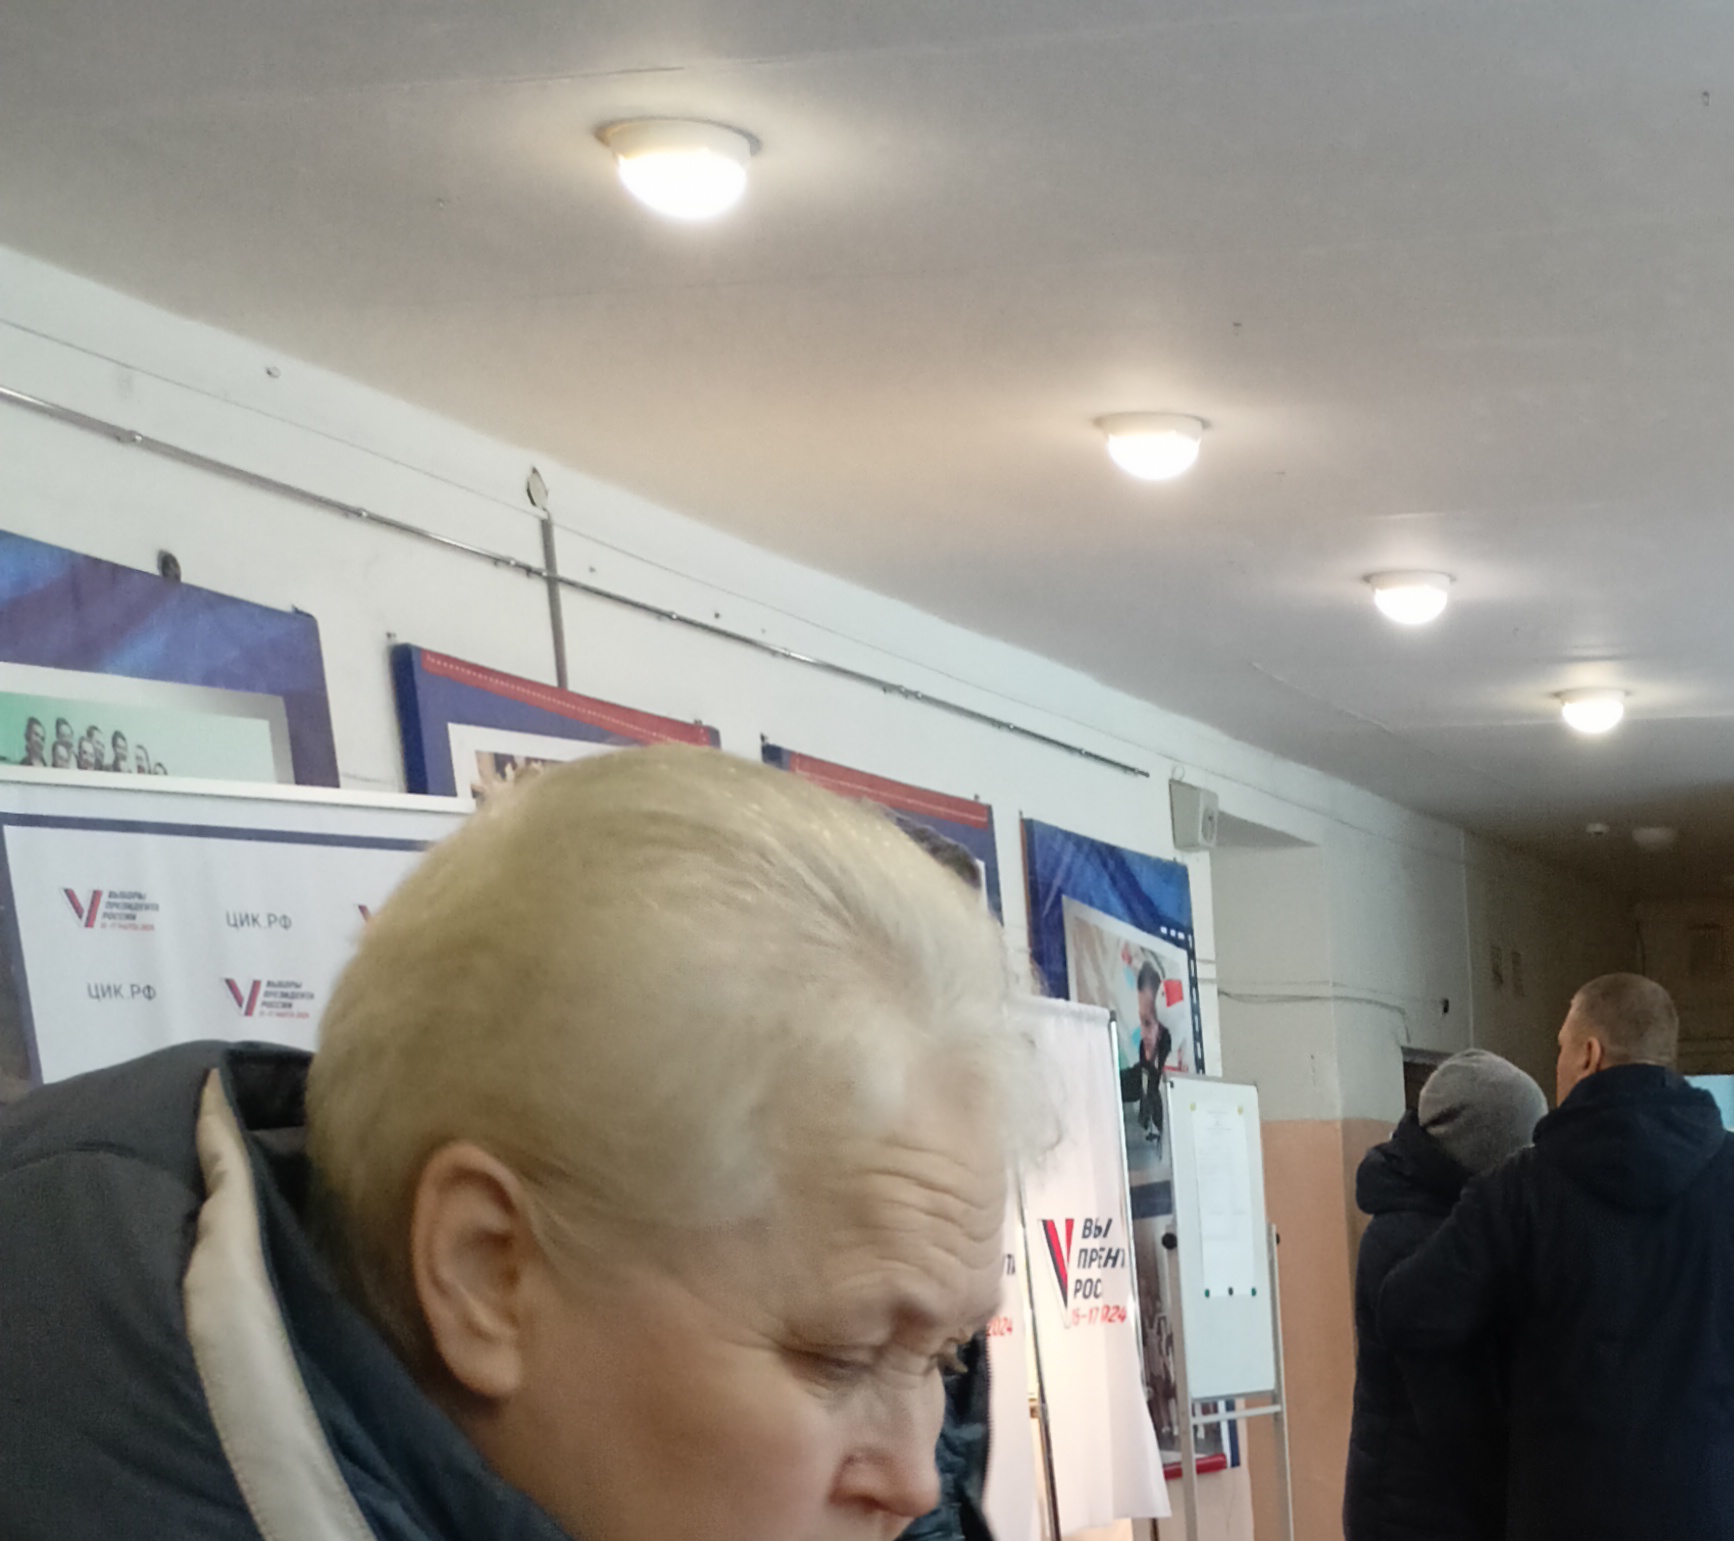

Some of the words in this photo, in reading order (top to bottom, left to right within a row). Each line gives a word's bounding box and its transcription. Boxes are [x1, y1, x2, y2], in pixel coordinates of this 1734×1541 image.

[225, 911, 292, 930] ЦИК.РФ
[86, 981, 157, 1001] ЦИК.РФ
[1082, 1218, 1113, 1240] ВЫ
[1074, 1278, 1103, 1299] РОС
